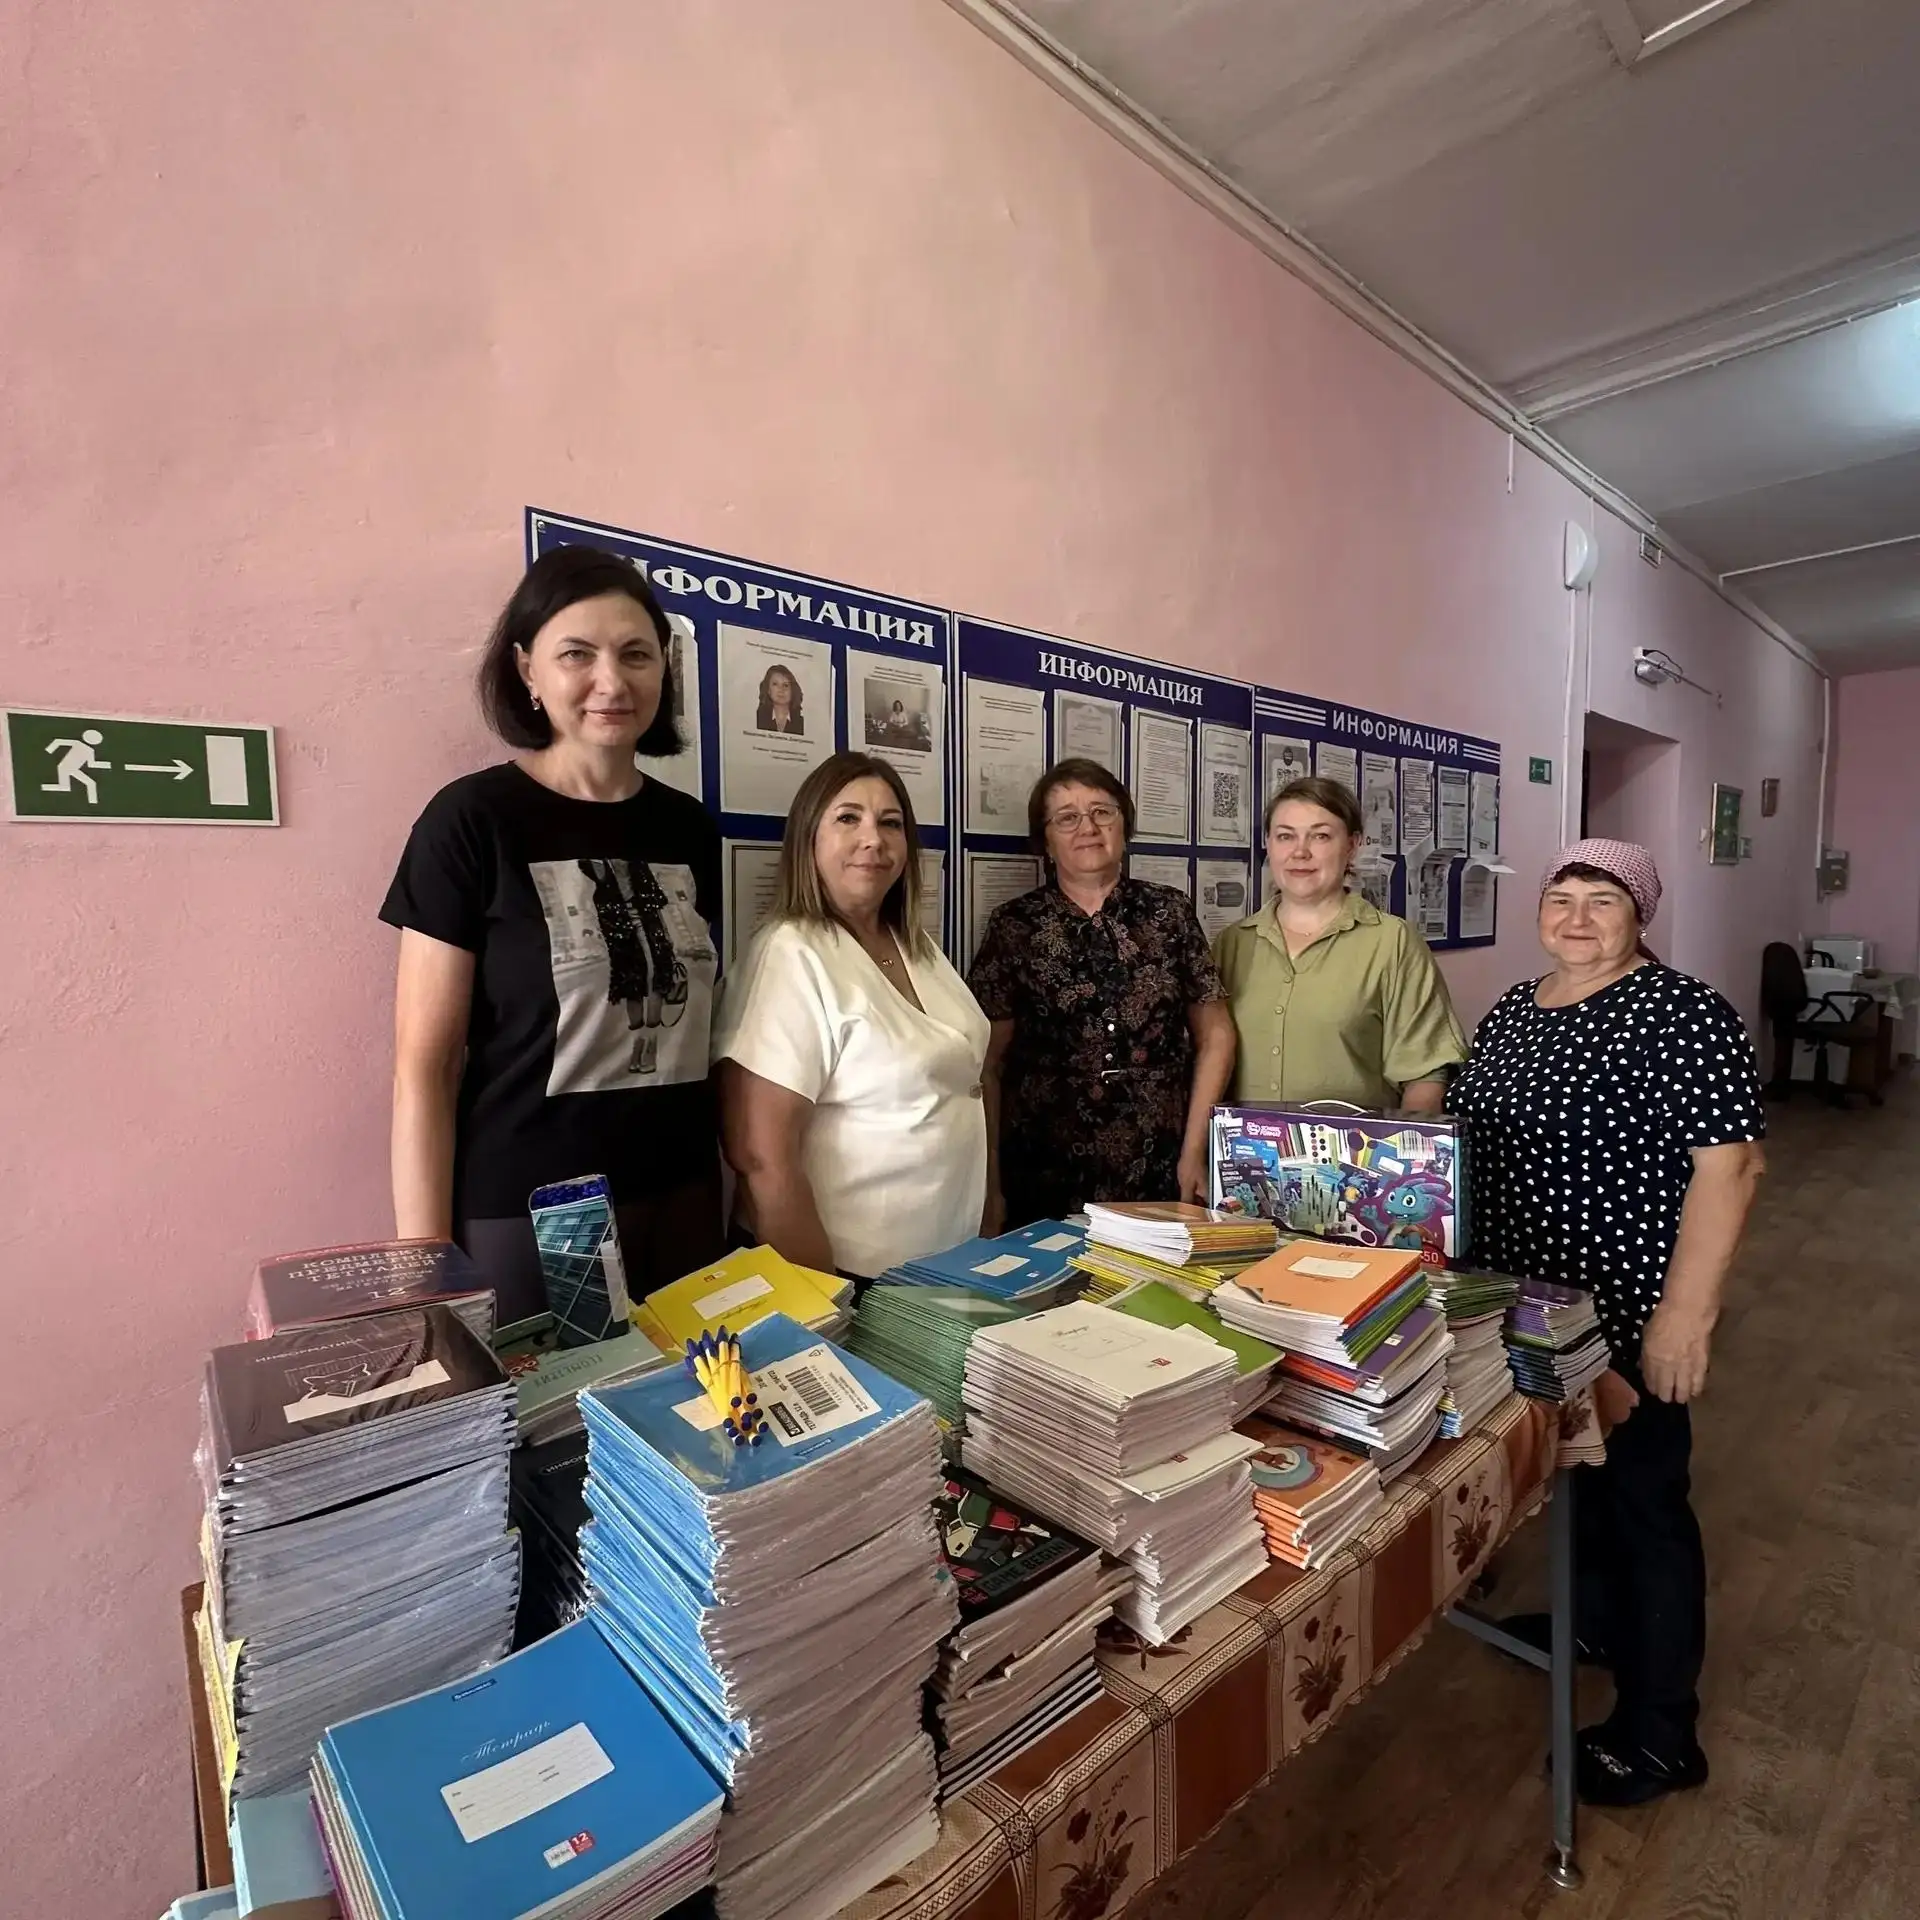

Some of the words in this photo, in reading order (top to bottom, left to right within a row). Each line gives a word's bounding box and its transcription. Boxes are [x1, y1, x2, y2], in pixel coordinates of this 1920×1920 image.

[559, 540, 935, 648] ФОРМАЦИЯ
[1038, 651, 1203, 706] ИНФОРМАЦИЯ
[1333, 710, 1458, 755] ИНФОРМАЦИЯ
[288, 1252, 447, 1279] ПРЕДМЕТНЫХ
[303, 1248, 426, 1269] КОМПЛЕКТ
[307, 1259, 437, 1283] ТЕТРАДЕЙ
[368, 1287, 406, 1300] 12
